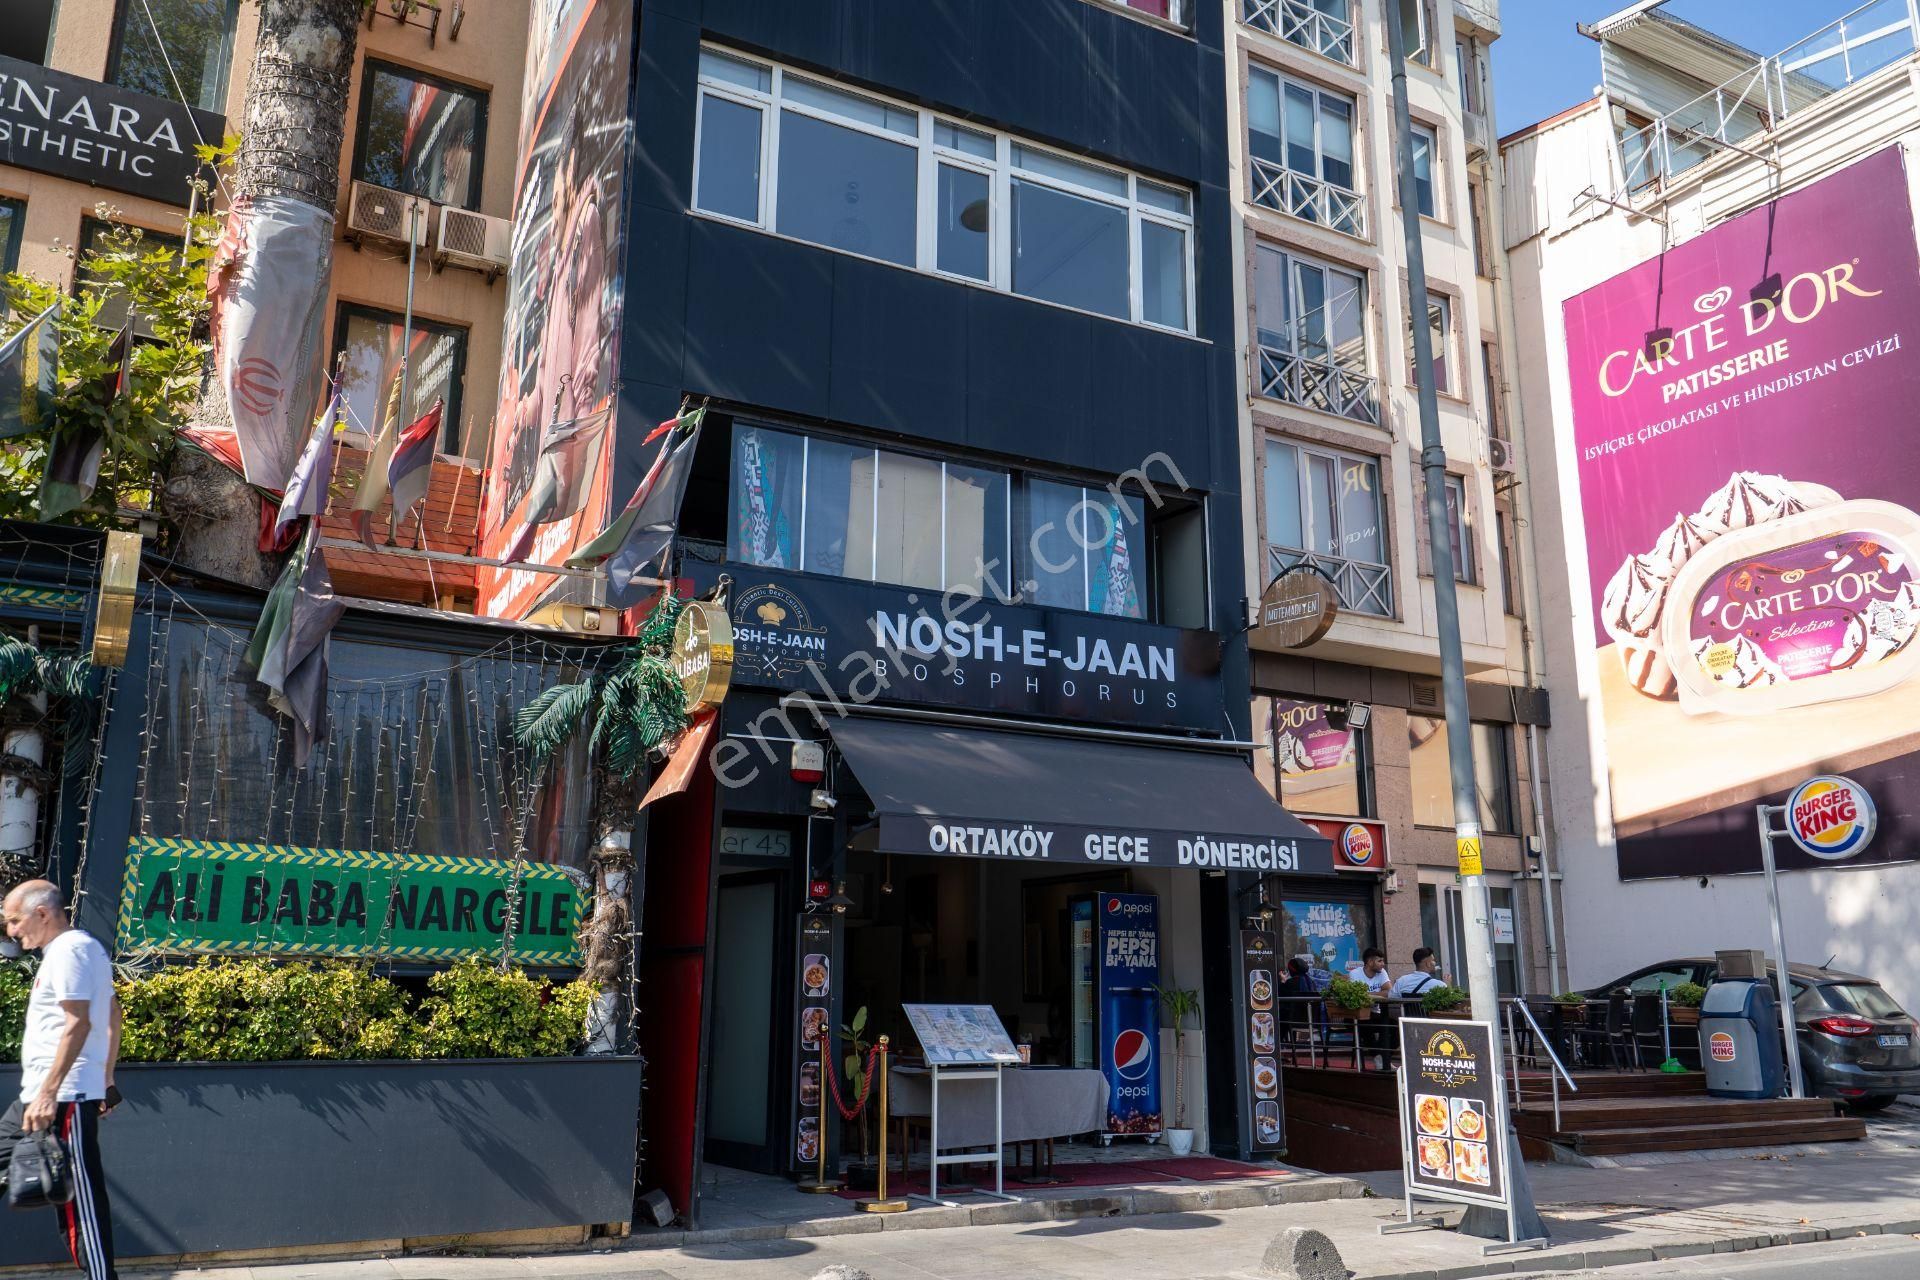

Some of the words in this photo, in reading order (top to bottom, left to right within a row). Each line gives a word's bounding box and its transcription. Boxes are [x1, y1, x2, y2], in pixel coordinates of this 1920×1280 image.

[1599, 313, 1728, 397] CARTE
[1662, 339, 1789, 403] PATISSERIE
[1585, 433, 1634, 461] İSVİÇRE
[1637, 404, 1718, 443] ÇİKOLATASI
[1721, 395, 1740, 412] VE
[1745, 359, 1837, 404] HİNDİSTAN
[1842, 333, 1901, 367] CEVİZİ
[1720, 589, 1804, 630] CARTE
[732, 627, 826, 650] OSH-E-JAAN
[1768, 618, 1835, 642] Selection
[876, 610, 1176, 682] NOSH-E-JAAN
[875, 659, 1178, 708] BOSPHORUS
[1794, 788, 1852, 822] BURGER
[1799, 801, 1857, 840] KING
[756, 833, 787, 855] 45
[929, 824, 1054, 858] ORTAKÖY
[1084, 833, 1149, 863] GECE
[1177, 835, 1299, 871] DÖNERCİSİ
[1348, 834, 1369, 846] BURGER
[1350, 839, 1371, 854] KING
[143, 862, 226, 922] ALİ
[241, 876, 368, 928] BABA
[392, 880, 571, 937] NARGİLE
[1124, 903, 1152, 915] pepsi
[1308, 904, 1343, 925] King
[1299, 921, 1351, 937] Bubbles
[1124, 954, 1157, 968] YANA
[1422, 1057, 1475, 1069] NOSH-E-JAAN
[1712, 1048, 1734, 1056] KING
[1117, 1084, 1150, 1099] pepsi
